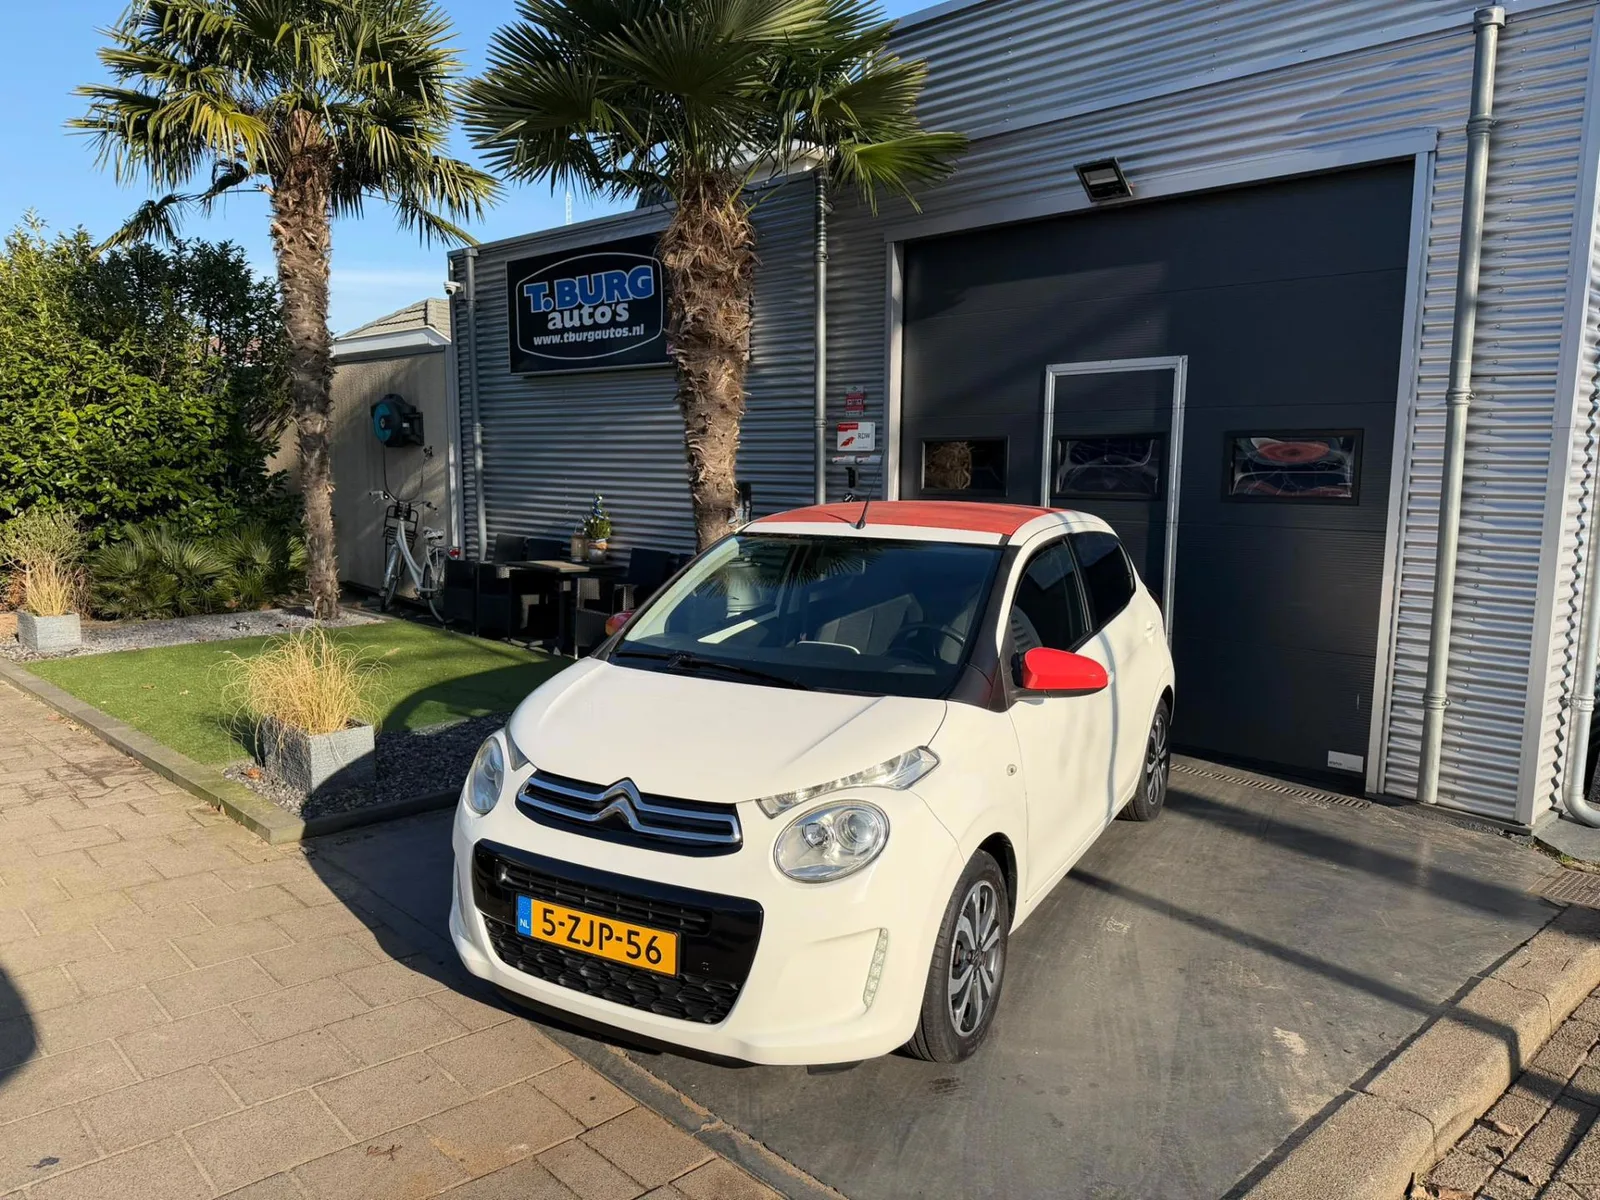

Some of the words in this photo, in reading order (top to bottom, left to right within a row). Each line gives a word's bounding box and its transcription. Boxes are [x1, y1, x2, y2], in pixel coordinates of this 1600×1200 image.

[524, 265, 654, 313] T.BURG
[547, 303, 629, 330] auto's
[533, 324, 645, 346] www.tburgautos.nl
[858, 432, 871, 440] RDW
[520, 918, 530, 929] NL
[542, 908, 662, 965] 5-ZJP-56
